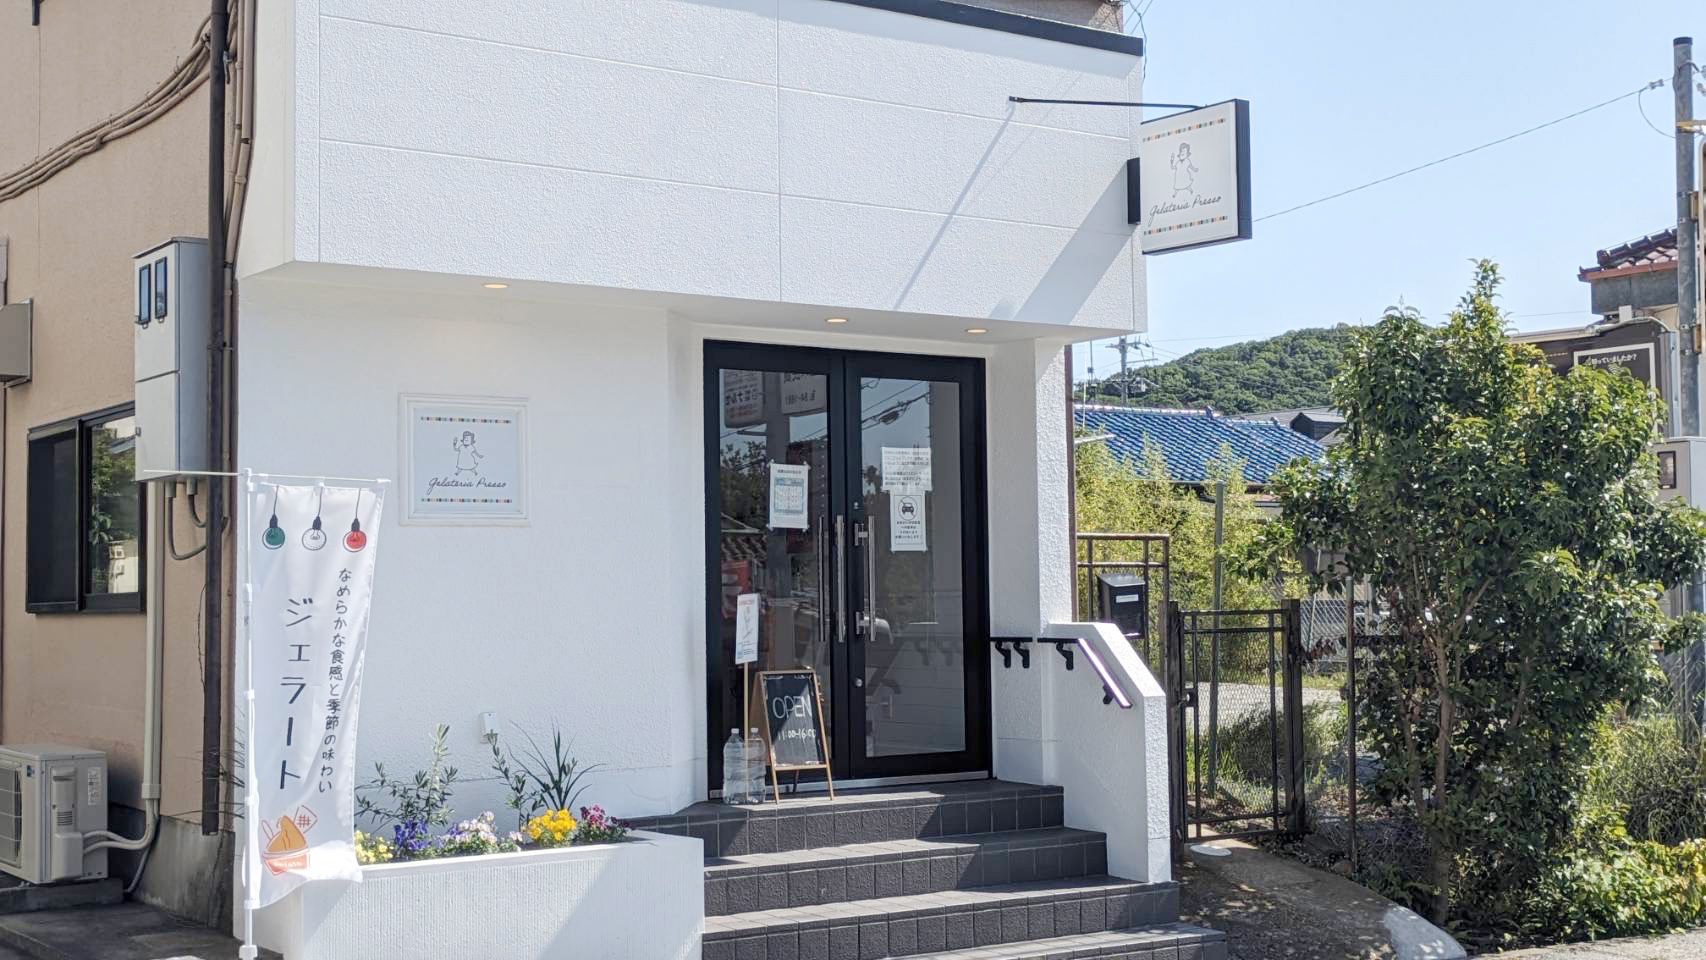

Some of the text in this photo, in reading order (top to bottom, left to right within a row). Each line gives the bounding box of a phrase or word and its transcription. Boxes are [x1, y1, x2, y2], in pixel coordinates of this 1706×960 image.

[280, 598, 313, 789] ジェラート
[318, 567, 352, 793] なめらかな食感と季節の味わい
[773, 695, 812, 718] OPEN
